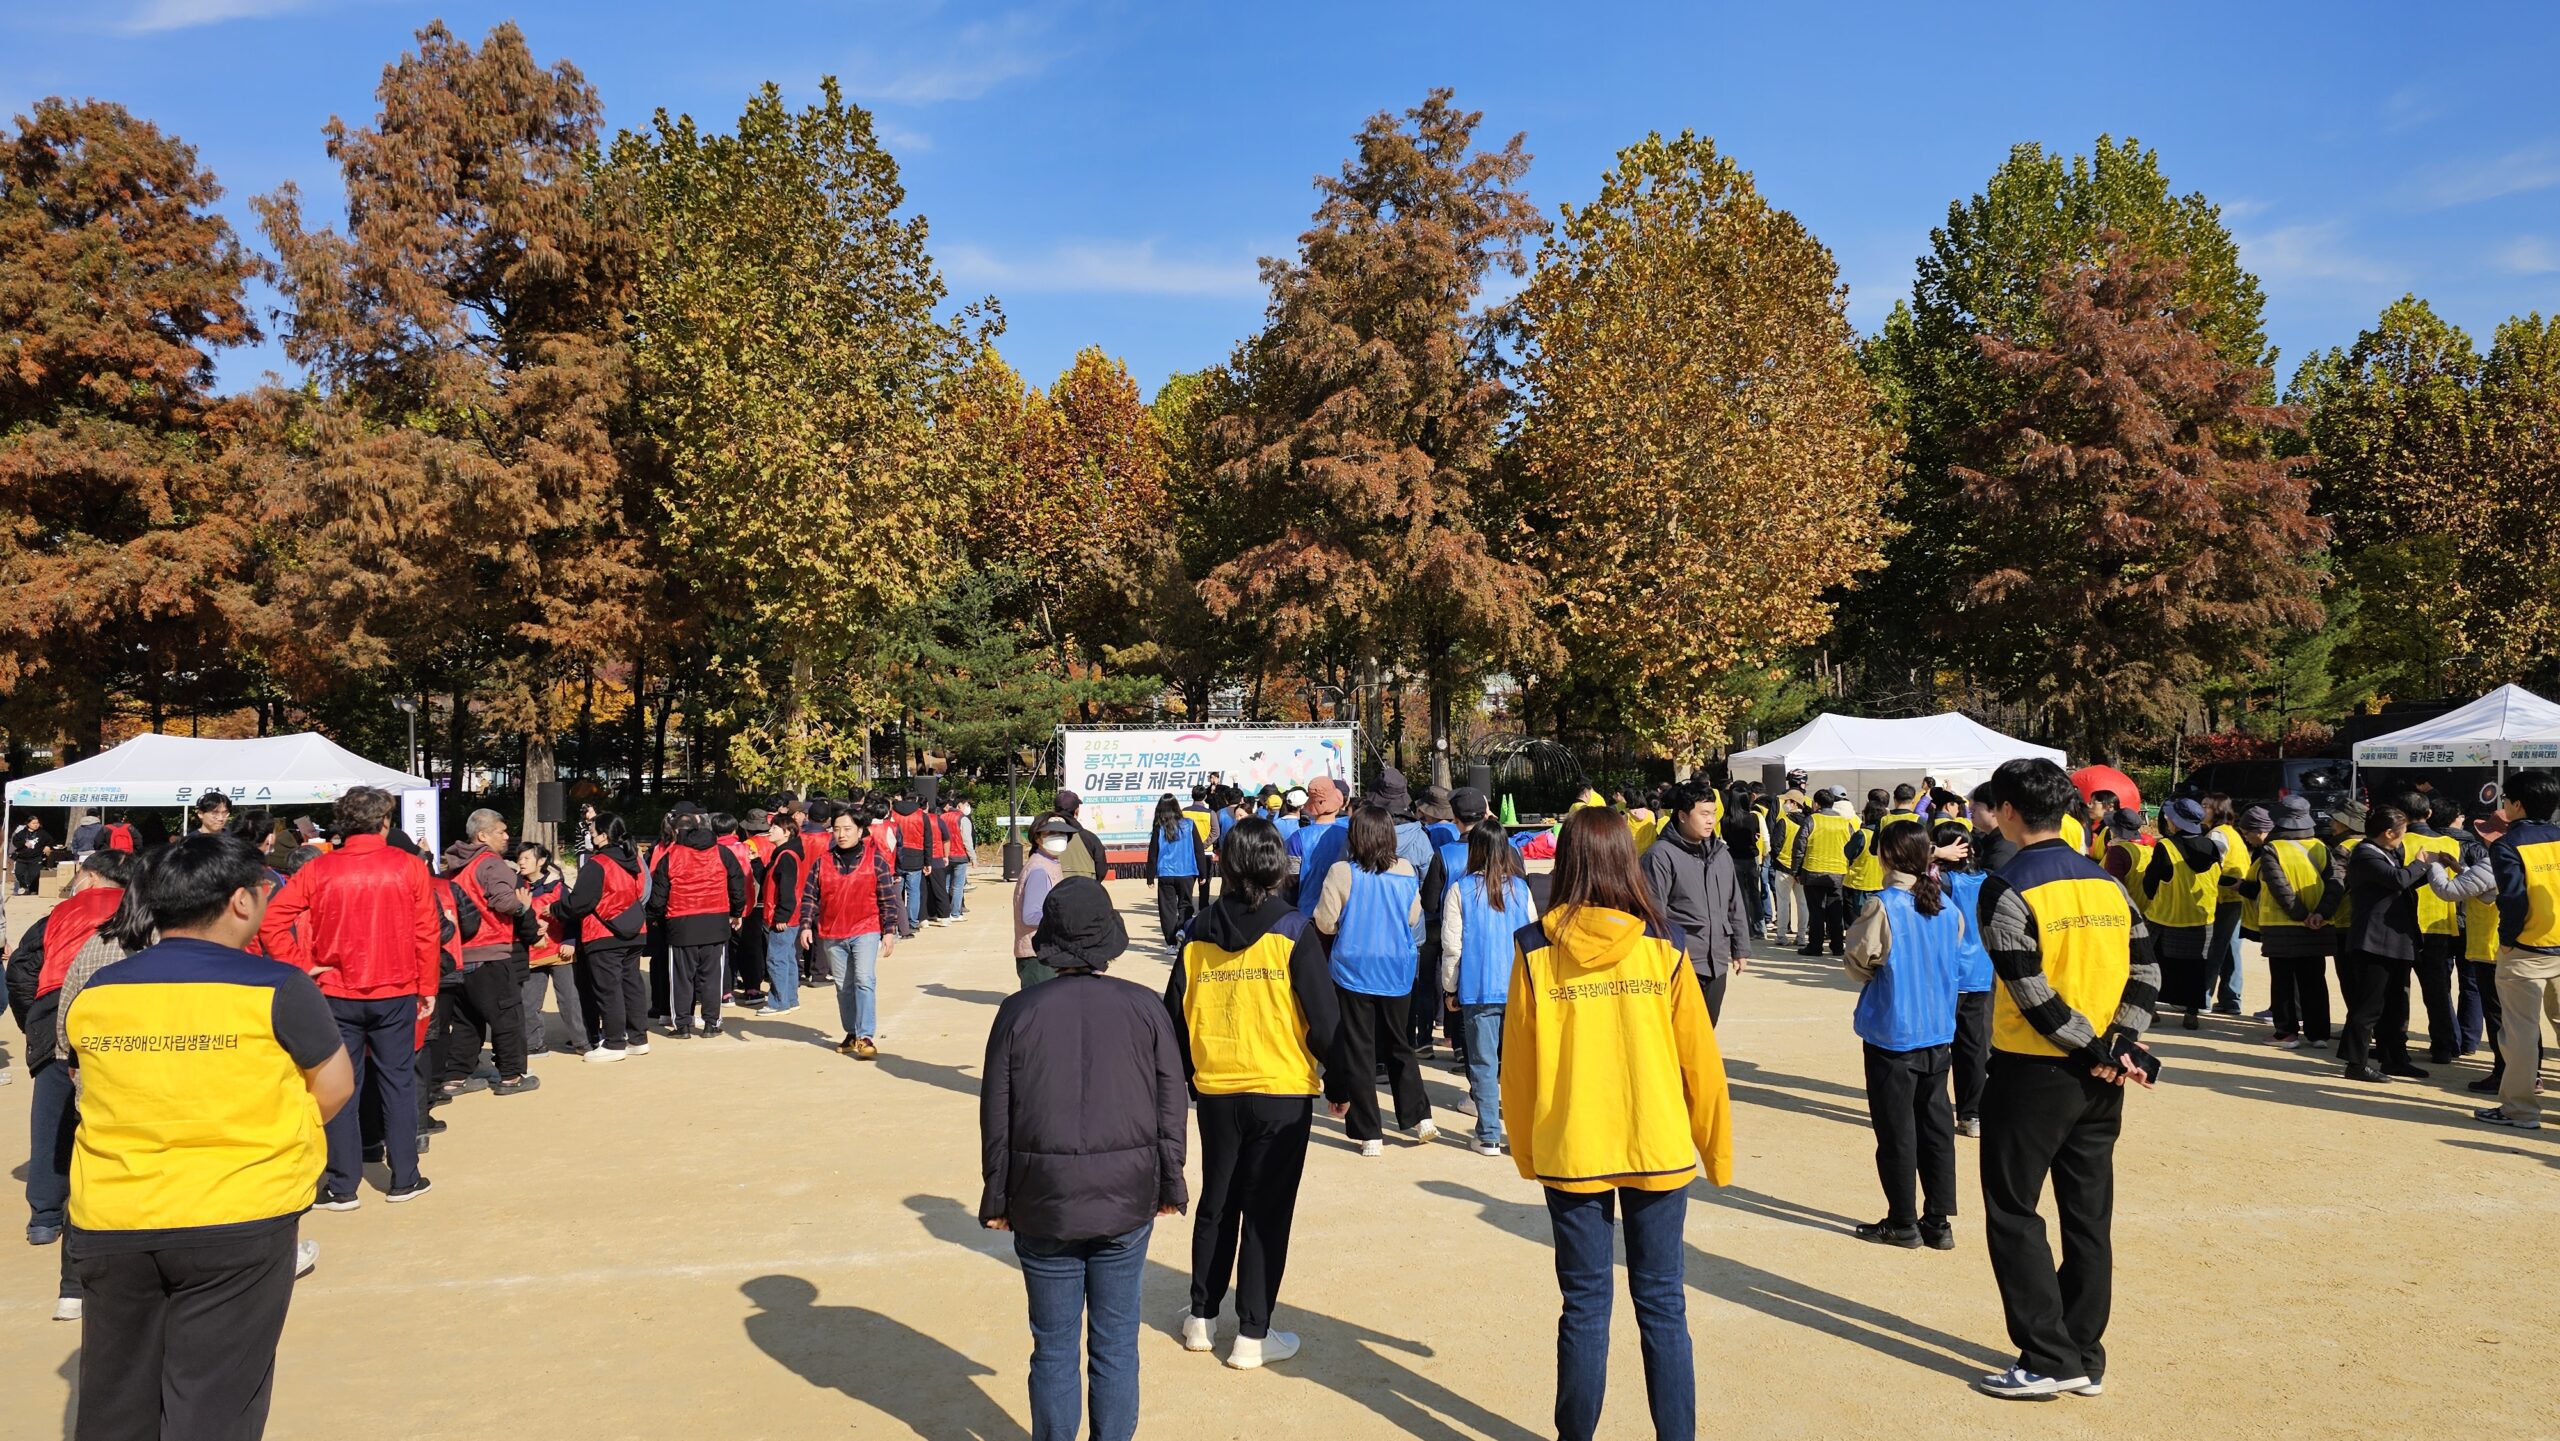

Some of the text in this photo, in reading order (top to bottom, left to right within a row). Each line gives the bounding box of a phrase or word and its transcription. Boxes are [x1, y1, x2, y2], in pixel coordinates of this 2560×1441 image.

[1084, 740, 1120, 751] 2025
[1084, 752, 1201, 770] 동작구 지역명소
[2409, 751, 2454, 763] 즐거운 한궁
[1084, 771, 1144, 792] 어울림
[59, 793, 128, 803] 어울림 체육대회
[80, 1033, 239, 1052] 우리동작장애인자립생활센터
